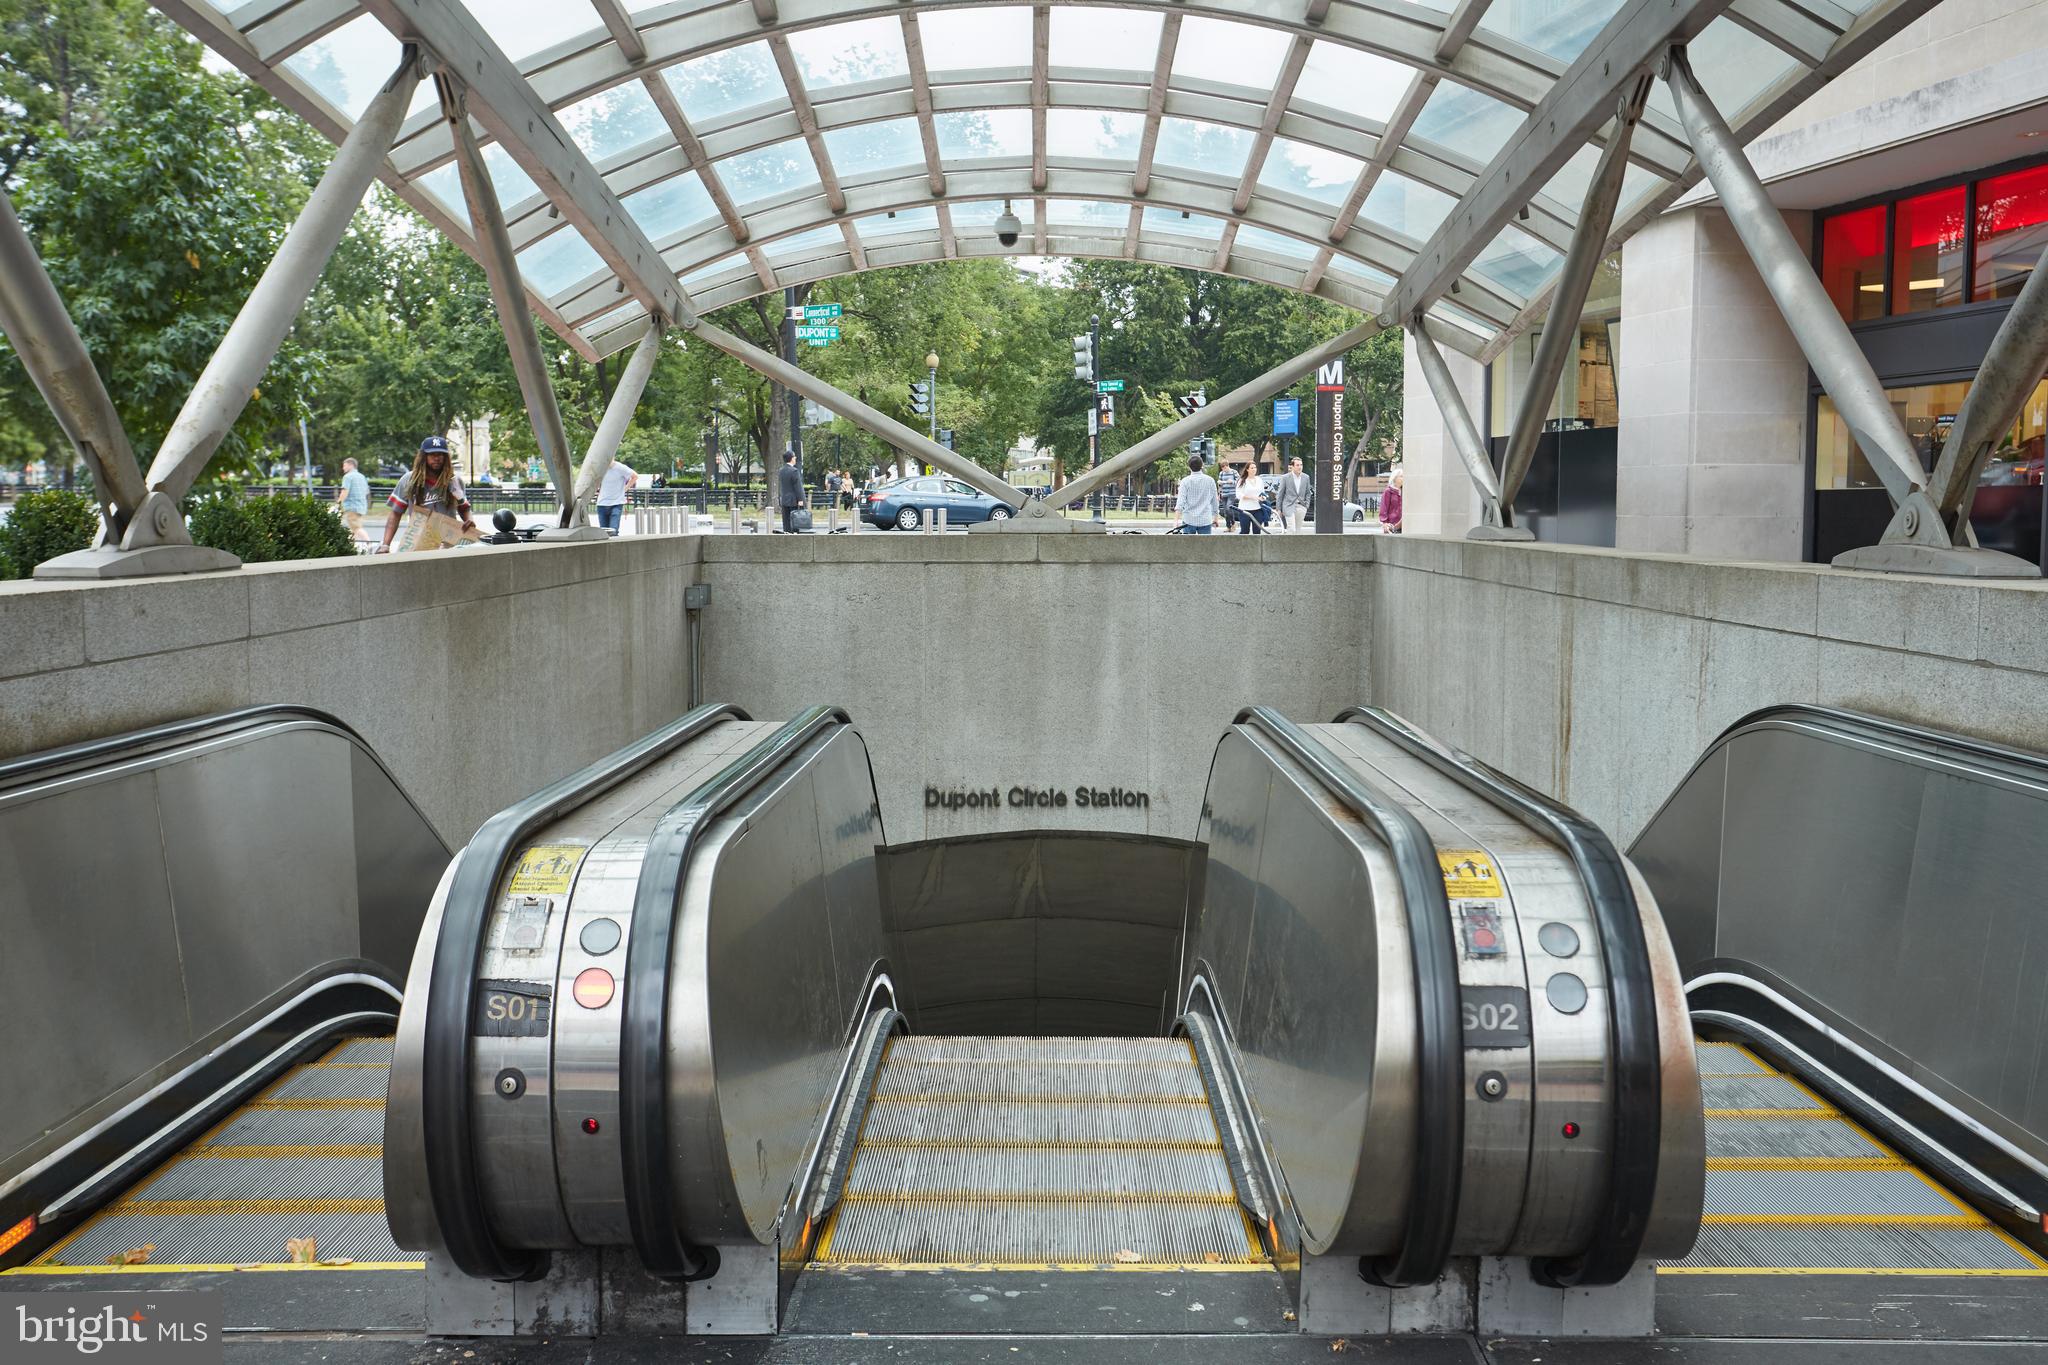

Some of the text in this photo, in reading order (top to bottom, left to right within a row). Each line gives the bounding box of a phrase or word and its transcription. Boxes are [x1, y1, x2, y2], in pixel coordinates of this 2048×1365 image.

[799, 327, 829, 338] DUPONT
[1318, 360, 1343, 385] M
[1332, 393, 1343, 500] Dupont Circle Station
[925, 786, 1149, 810] Dupont Circle Station
[486, 995, 539, 1021] S01
[1462, 1003, 1519, 1030] S02
